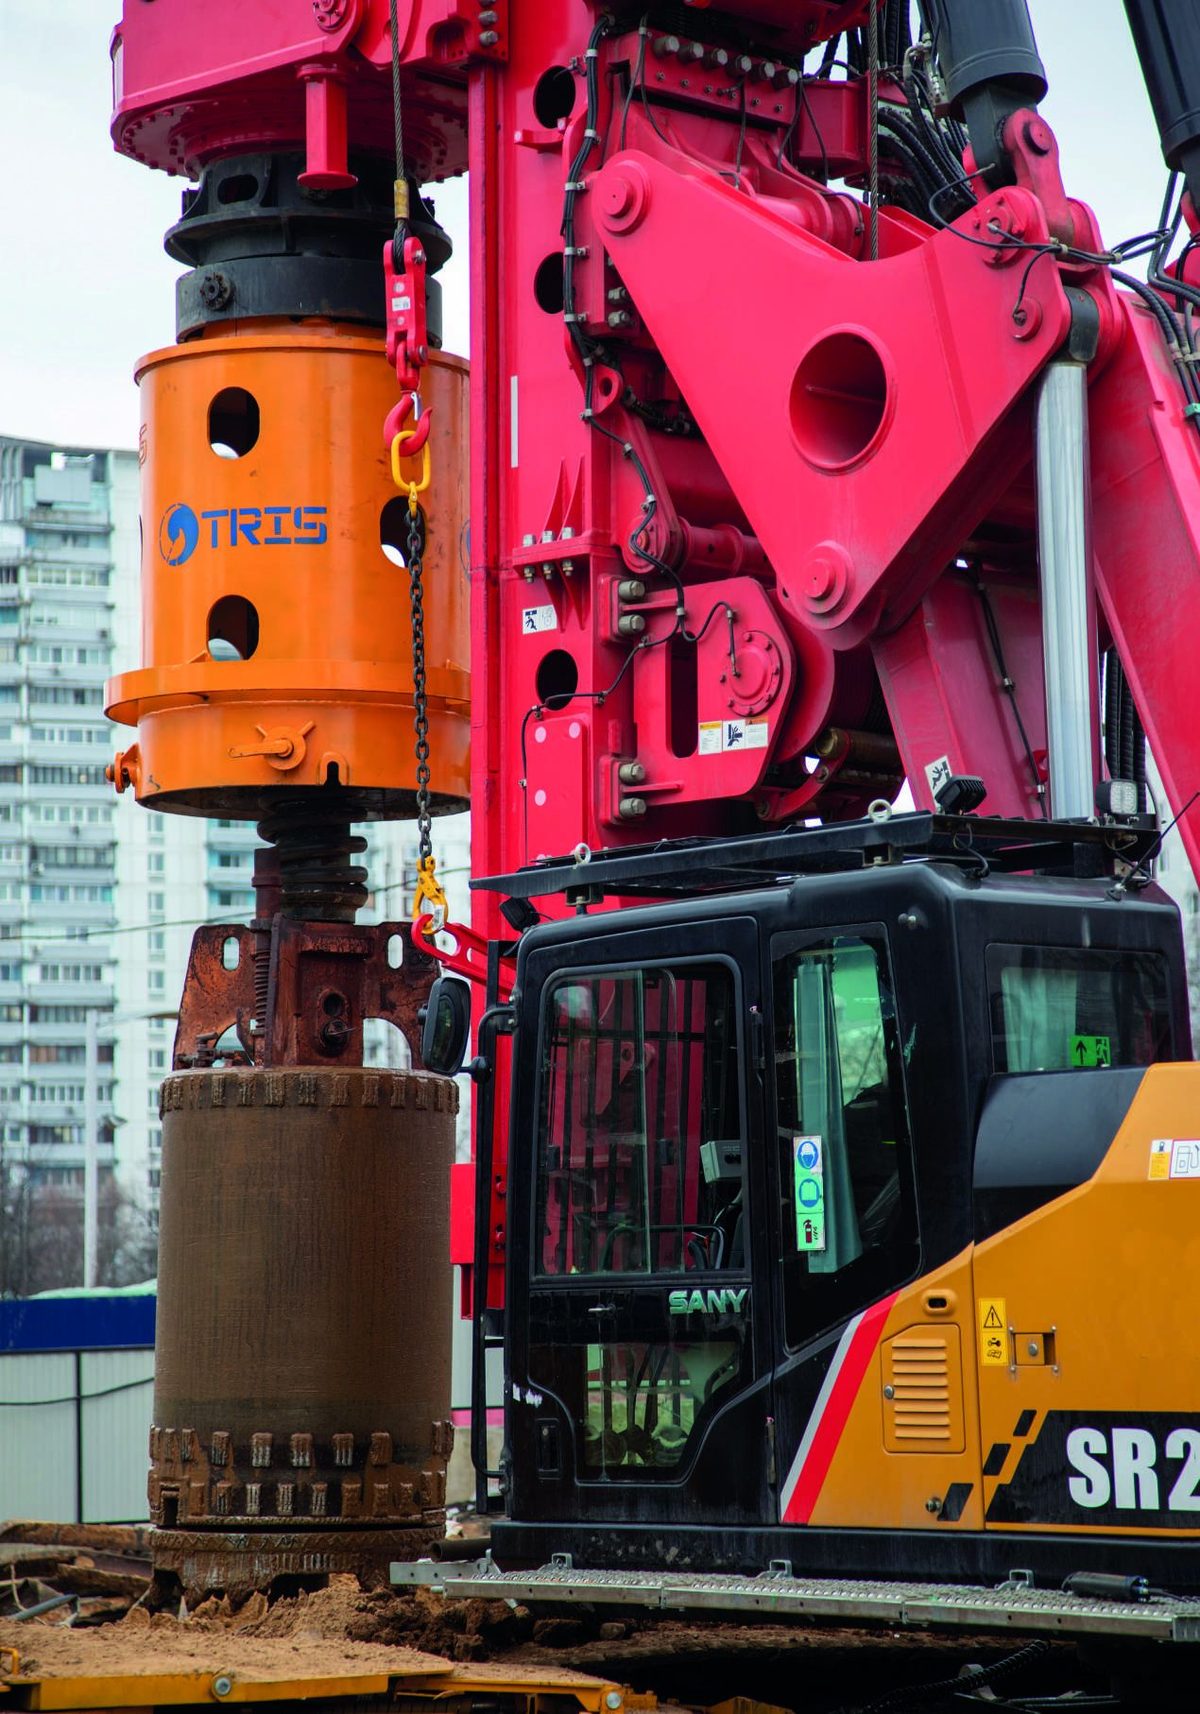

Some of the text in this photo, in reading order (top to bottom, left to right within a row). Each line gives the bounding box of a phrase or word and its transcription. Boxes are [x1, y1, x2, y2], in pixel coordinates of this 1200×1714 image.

[201, 506, 328, 549] TRIS
[668, 1288, 748, 1315] SANY
[1066, 1427, 1200, 1511] SR2
